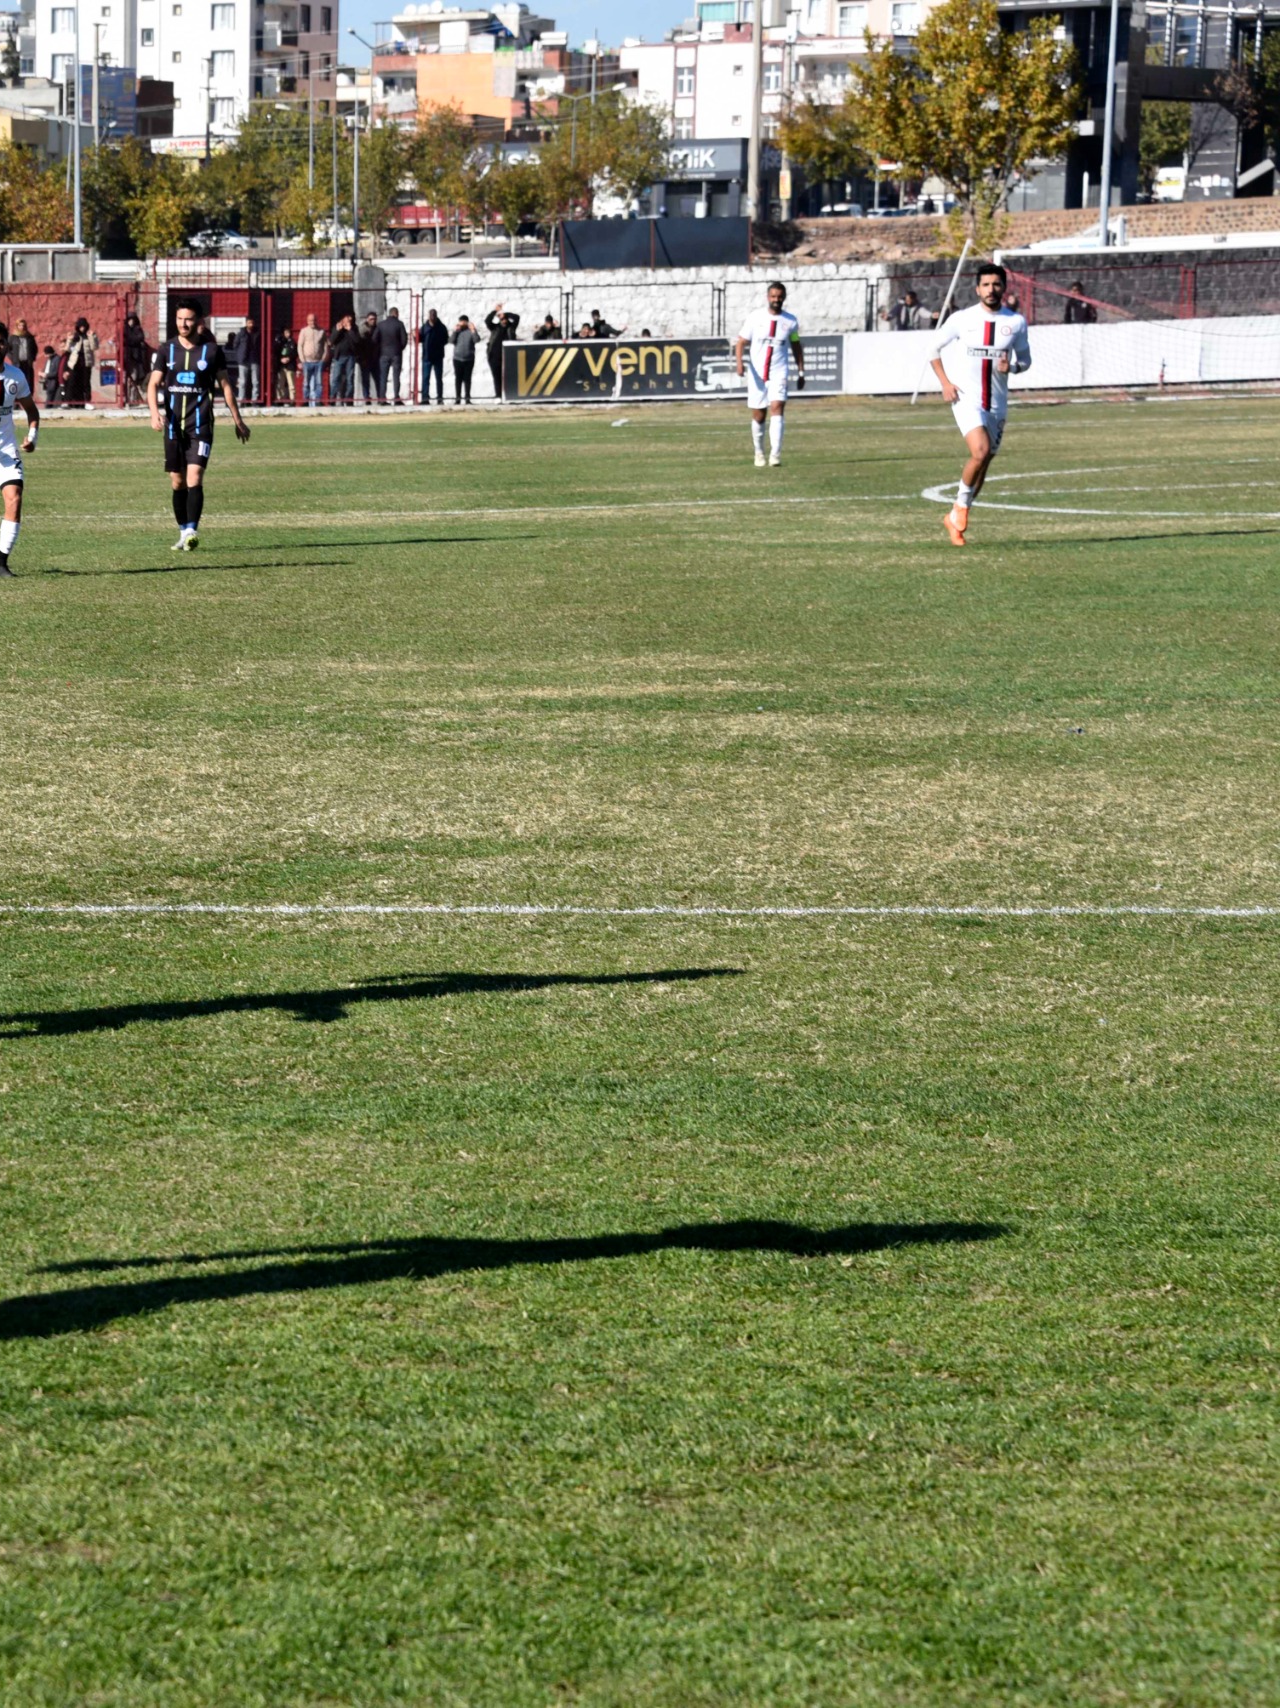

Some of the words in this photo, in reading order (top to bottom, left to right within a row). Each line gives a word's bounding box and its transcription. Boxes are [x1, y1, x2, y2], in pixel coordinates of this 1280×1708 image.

[583, 344, 688, 377] venn
[583, 379, 689, 392] Seahat
[197, 440, 210, 457] 10
